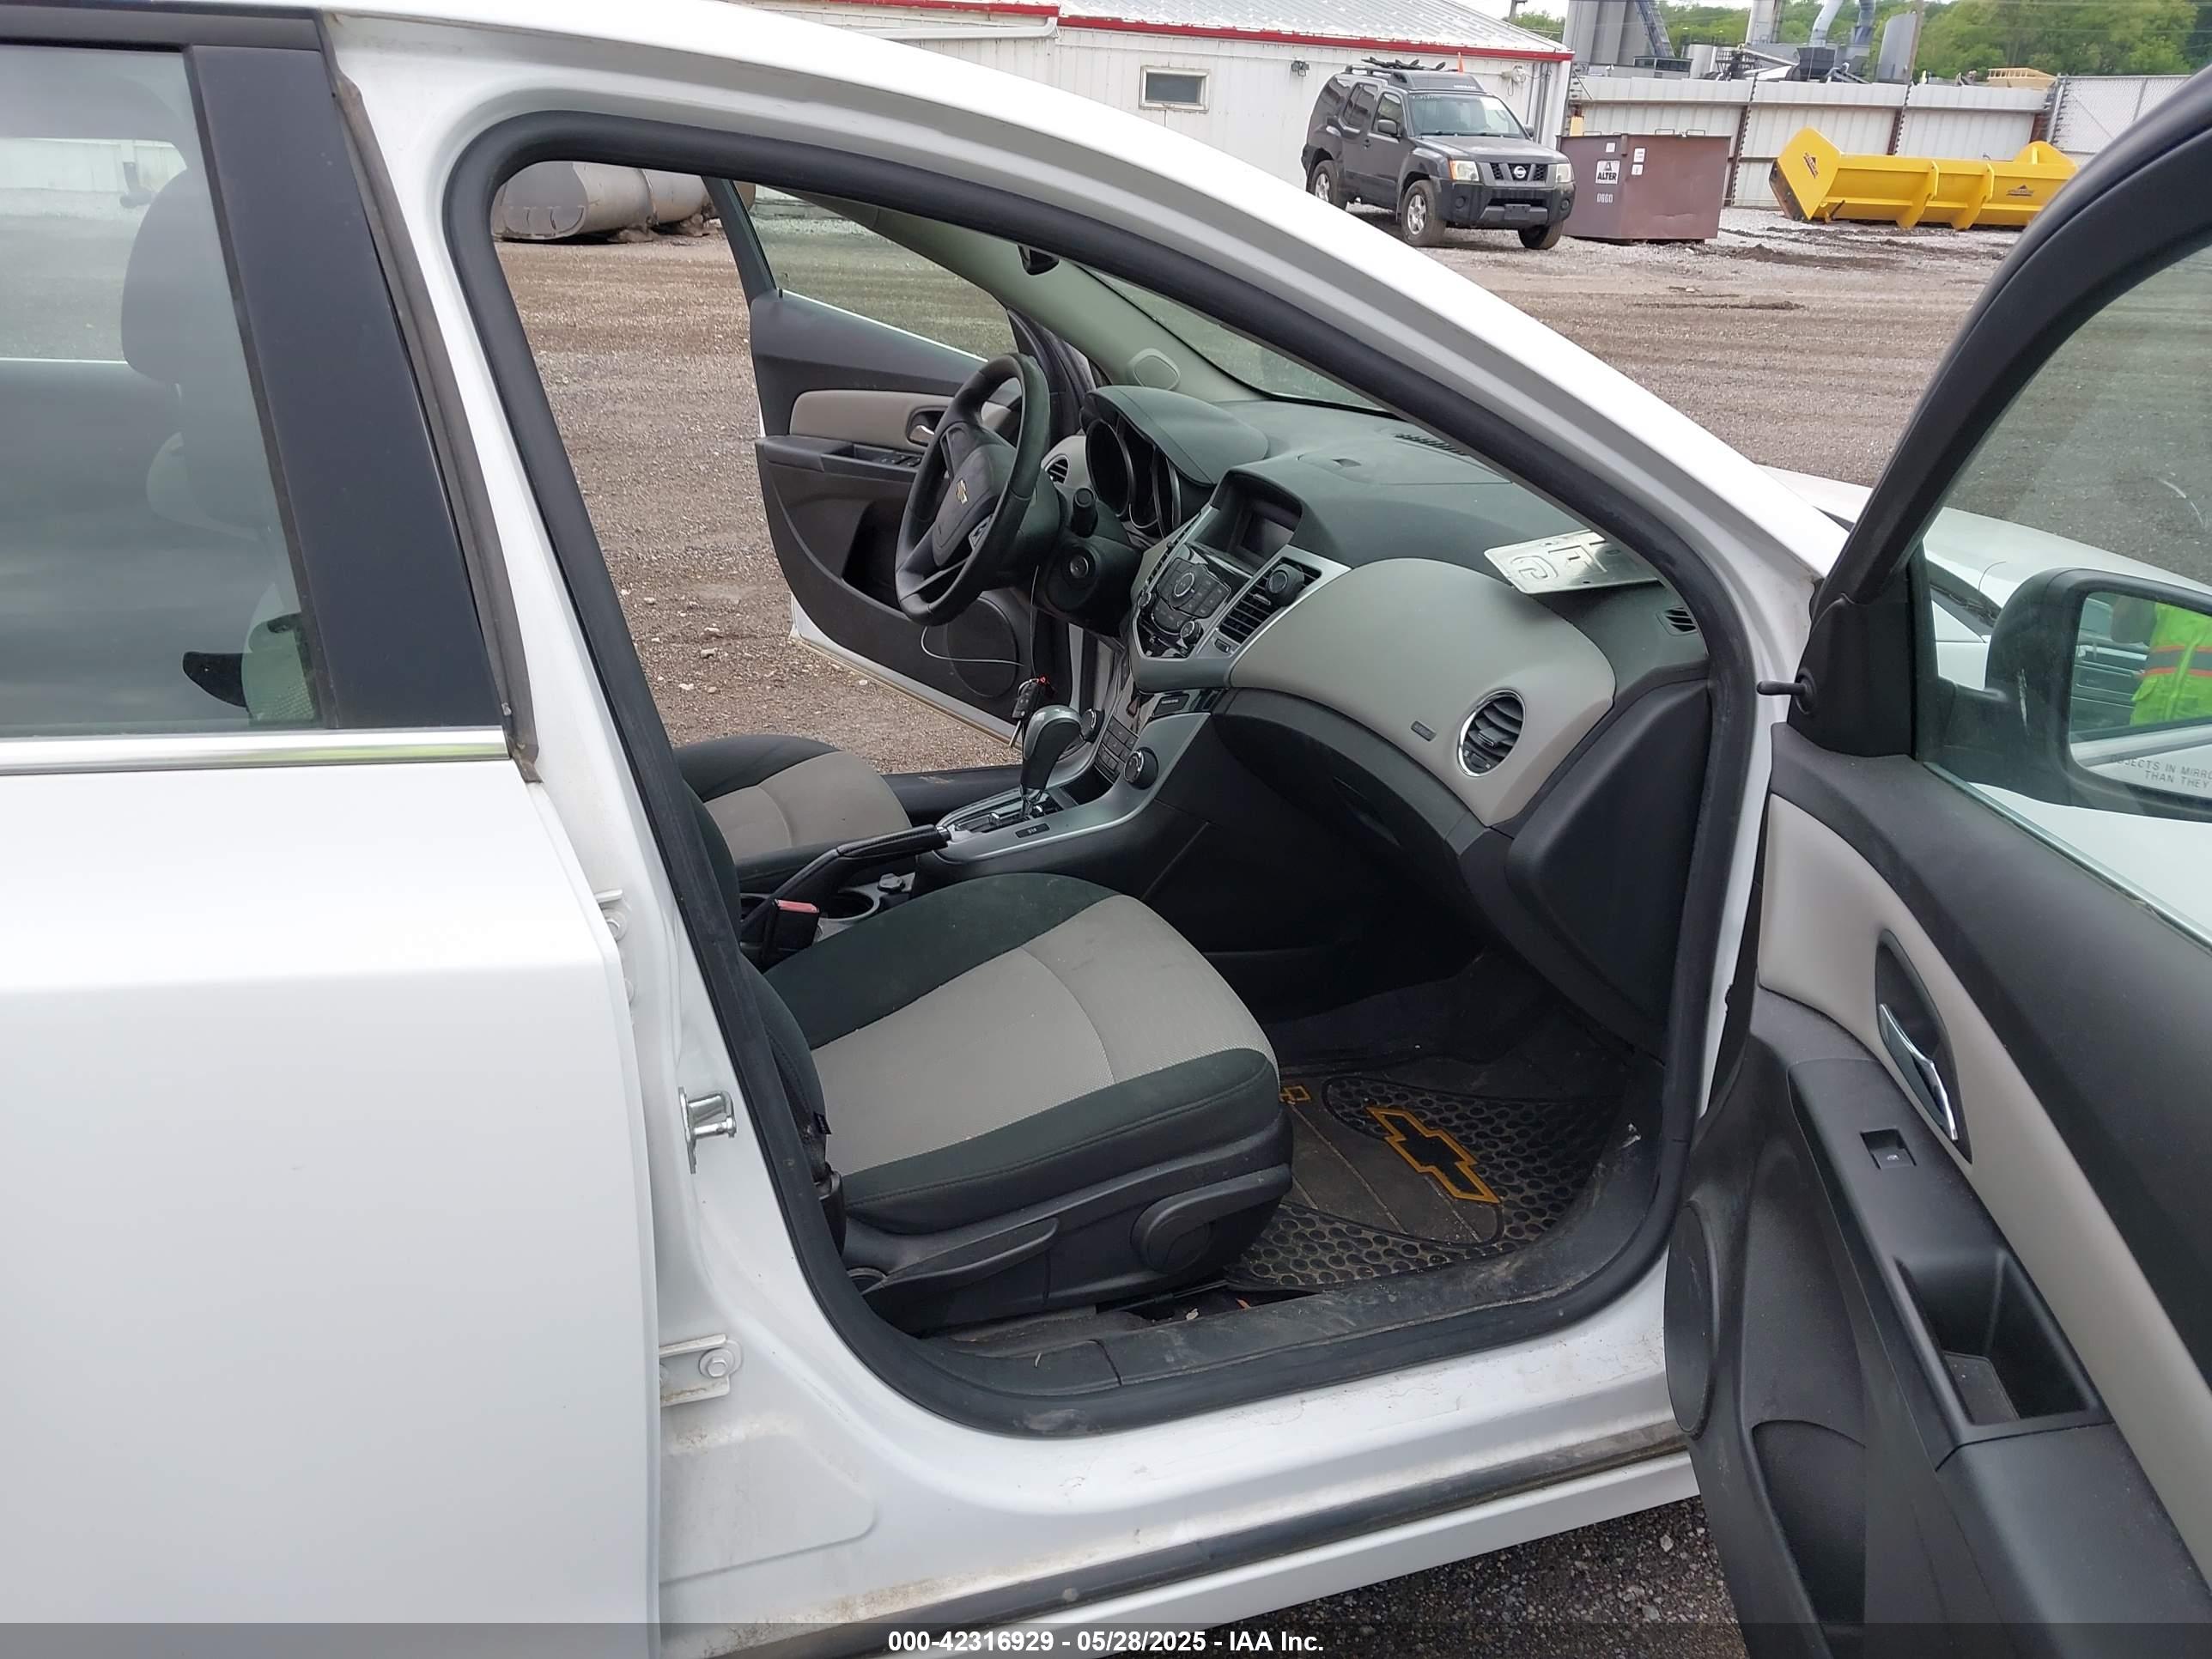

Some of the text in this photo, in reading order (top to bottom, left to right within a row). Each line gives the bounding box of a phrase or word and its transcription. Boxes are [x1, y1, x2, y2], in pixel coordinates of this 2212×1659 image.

[1597, 172, 1617, 181] ALTER
[2165, 763, 2176, 773] IN
[2145, 770, 2210, 788] THAN THEY
